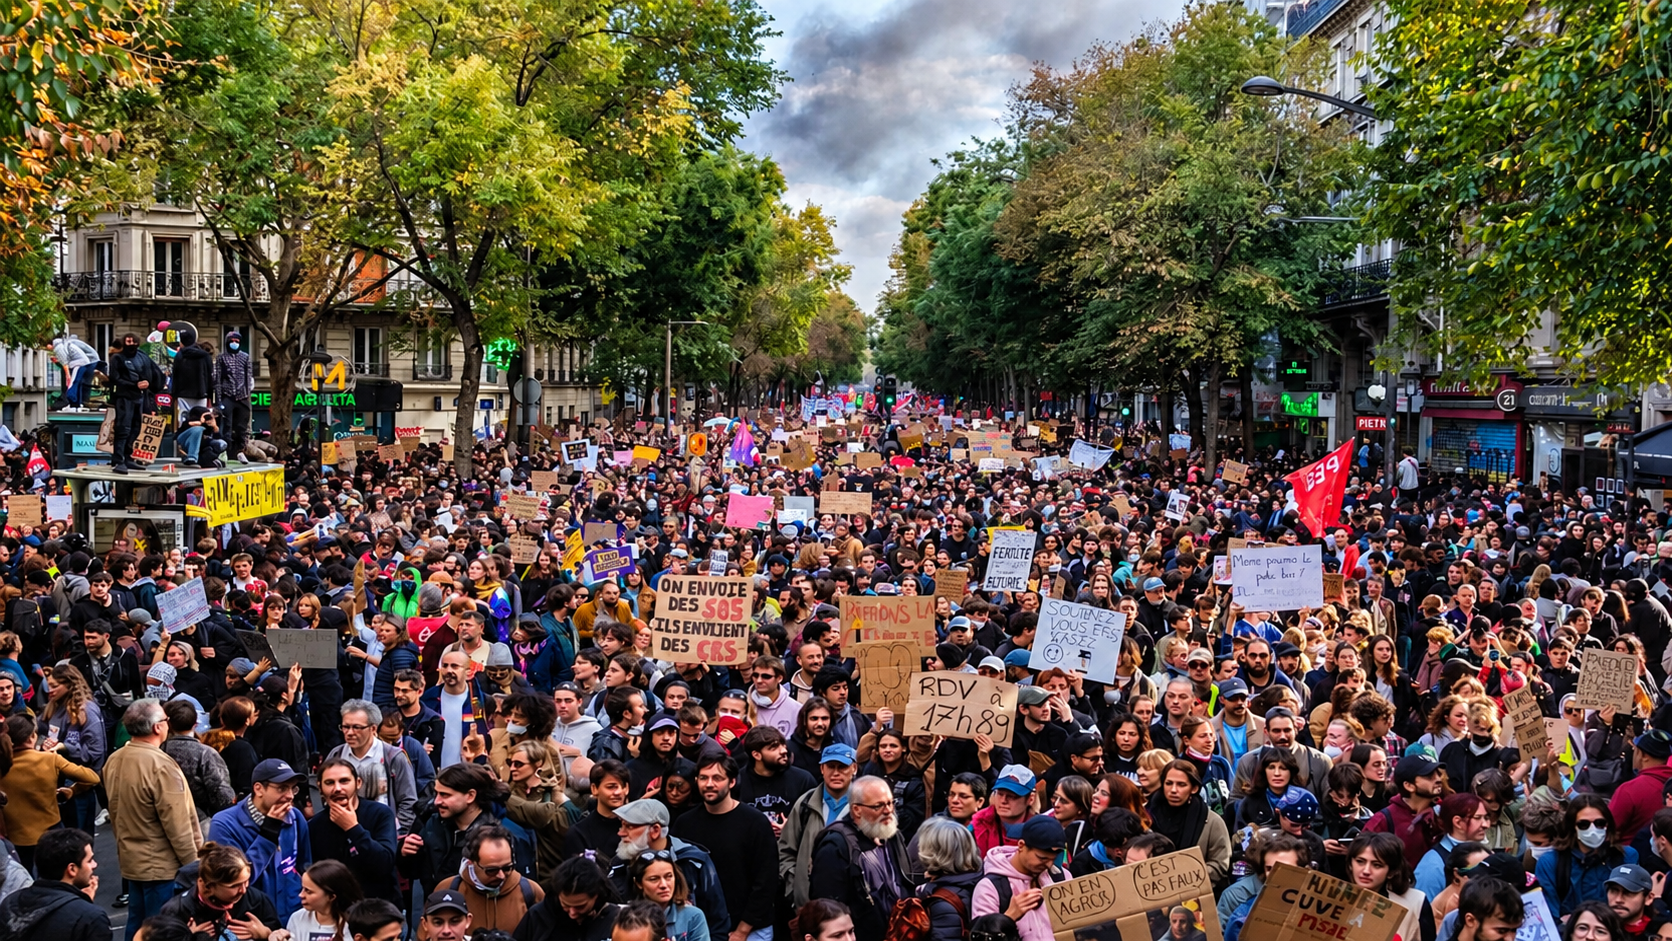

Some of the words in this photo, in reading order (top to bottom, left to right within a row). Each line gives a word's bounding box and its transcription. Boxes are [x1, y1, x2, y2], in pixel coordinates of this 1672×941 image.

[1503, 395, 1515, 405] 21
[661, 578, 683, 594] ON
[687, 580, 748, 598] ENVOIE
[668, 596, 699, 613] DES
[701, 597, 744, 622] SOS
[916, 601, 934, 619] LA
[654, 617, 681, 634] ILS
[1050, 616, 1088, 634] VOUS
[660, 637, 690, 653] DES
[696, 640, 738, 662] CRS
[919, 676, 977, 700] RDV
[920, 703, 1010, 744] 17h89
[1137, 856, 1176, 880] C'EST
[1049, 883, 1074, 900] ON
[1078, 876, 1101, 894] EN
[1142, 878, 1167, 897] PAS
[1168, 869, 1203, 891] FAUX
[1281, 888, 1346, 921] CUVE
